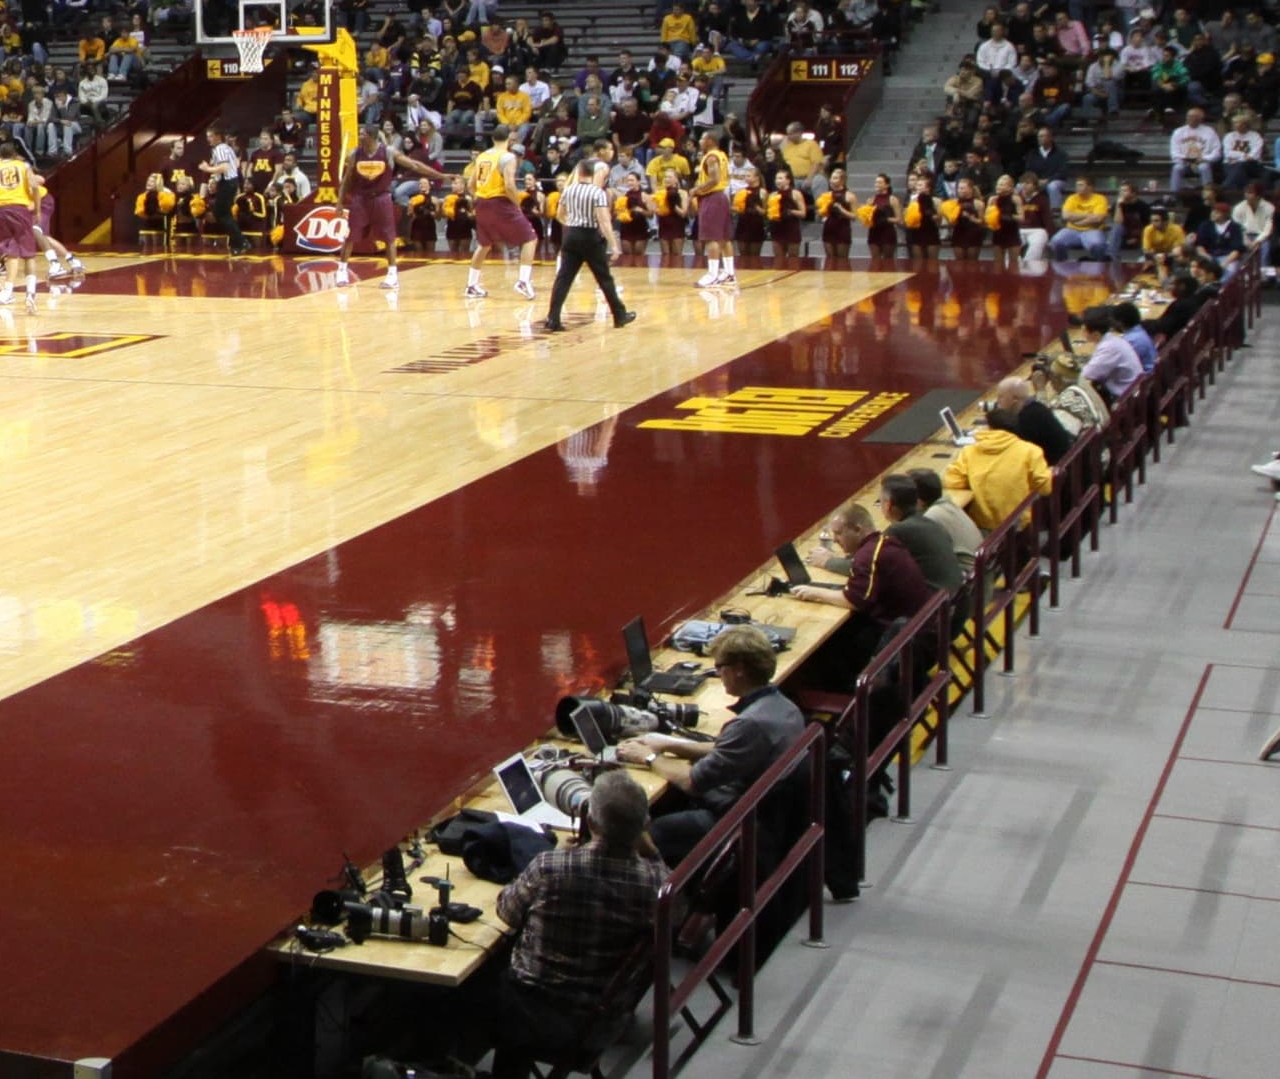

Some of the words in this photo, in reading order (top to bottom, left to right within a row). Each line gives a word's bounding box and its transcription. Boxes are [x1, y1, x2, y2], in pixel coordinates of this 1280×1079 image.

[223, 63, 238, 74] 110
[812, 64, 828, 76] 111
[841, 64, 858, 76] 112
[319, 74, 332, 182] MINNESOTA
